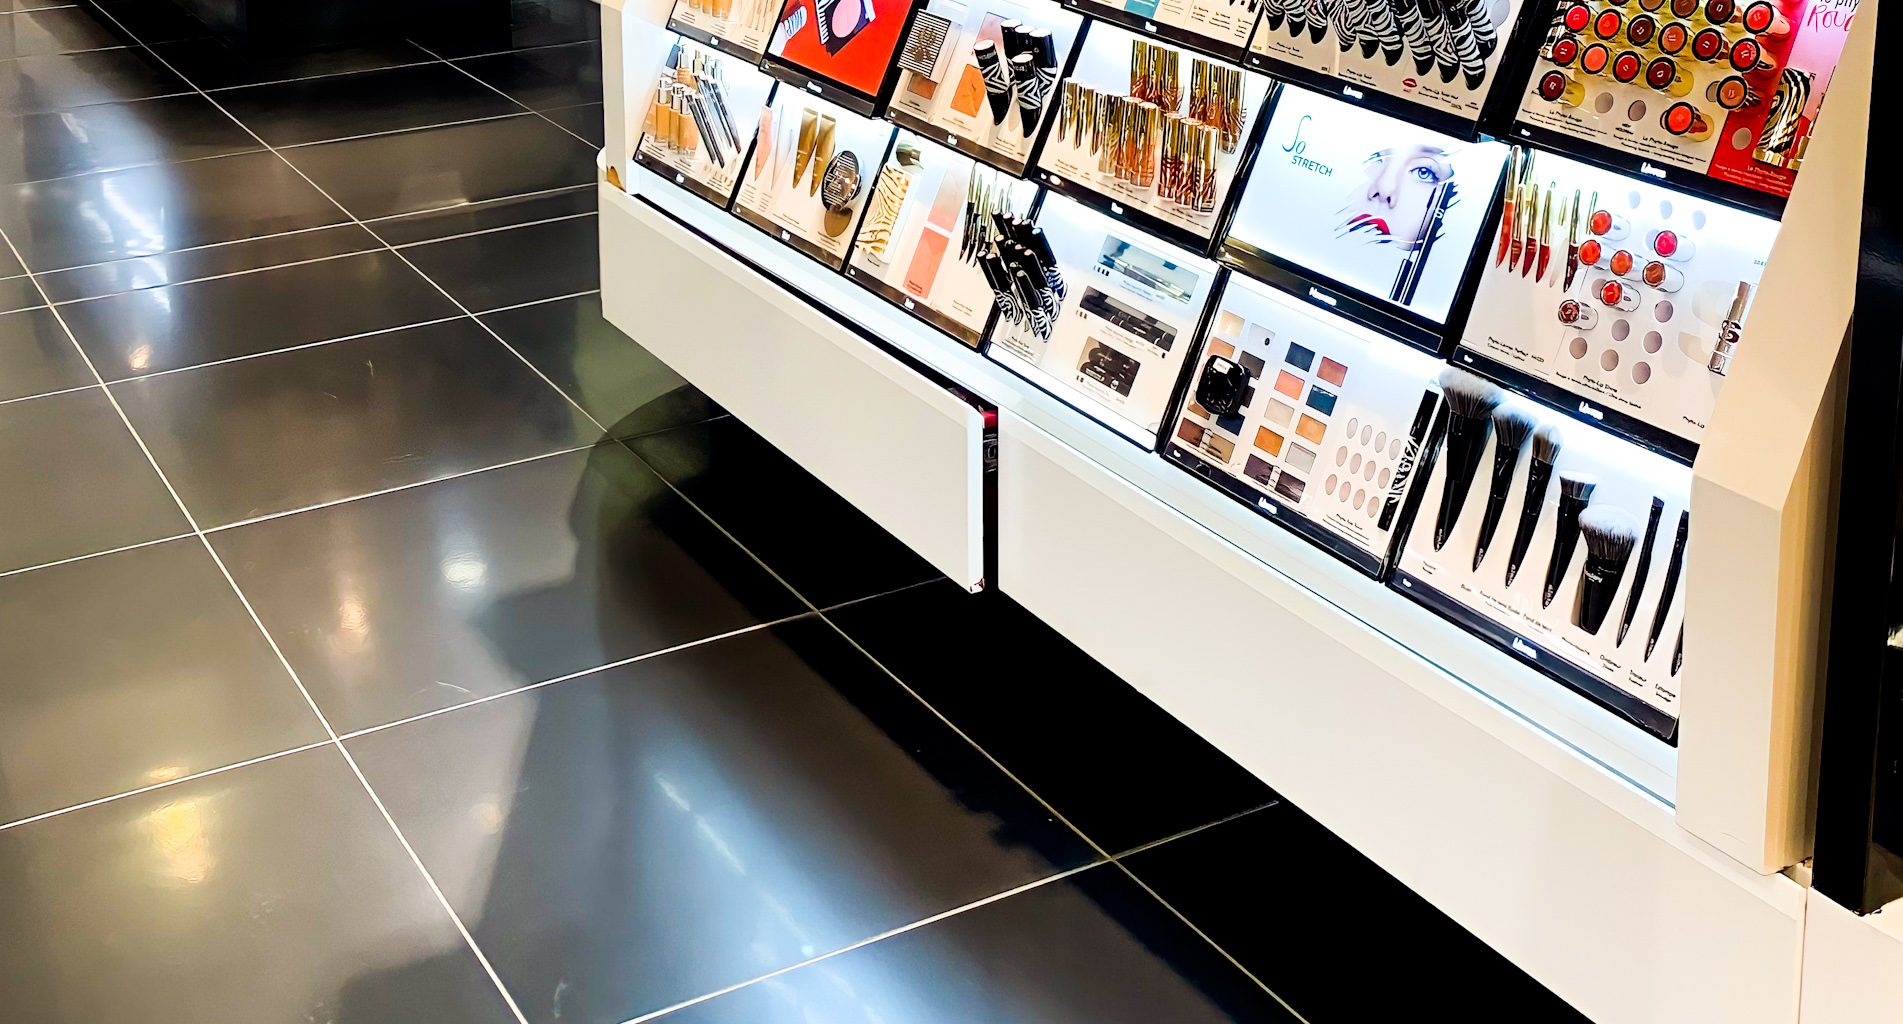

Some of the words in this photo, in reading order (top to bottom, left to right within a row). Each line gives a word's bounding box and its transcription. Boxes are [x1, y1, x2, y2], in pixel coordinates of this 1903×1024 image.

[1806, 4, 1857, 33] ROU
[1281, 114, 1312, 154] So
[1291, 155, 1334, 178] STRETCH
